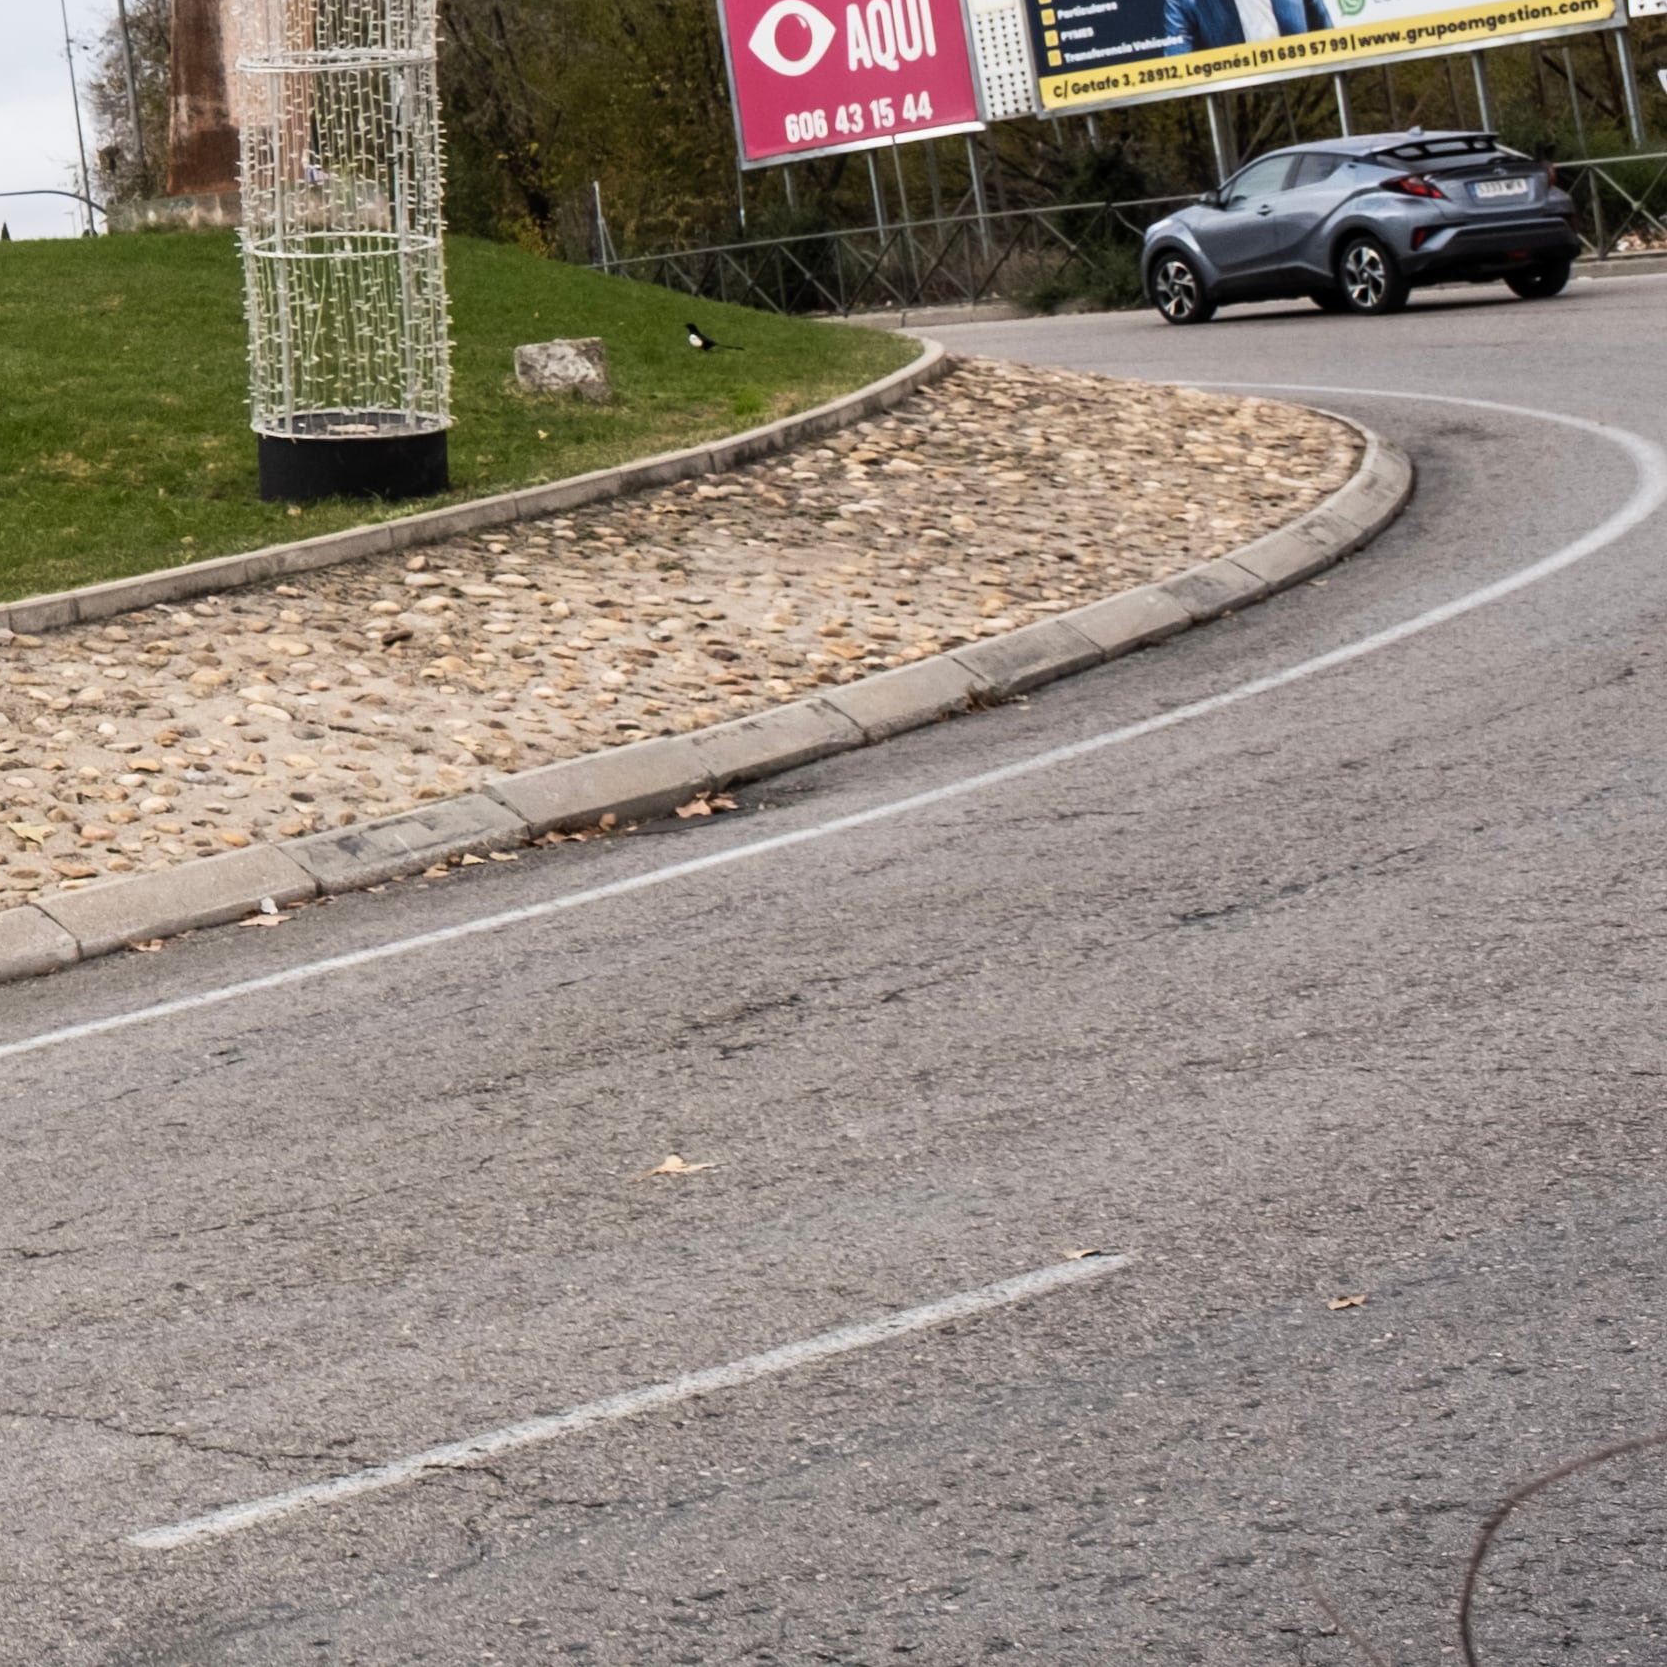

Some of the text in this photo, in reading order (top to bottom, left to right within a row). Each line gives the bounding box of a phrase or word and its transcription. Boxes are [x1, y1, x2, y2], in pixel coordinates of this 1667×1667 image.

[1056, 1, 1118, 21] Particulares
[1053, 80, 1069, 99] C/
[1071, 76, 1119, 95] Getafe
[1121, 73, 1136, 87] 3,
[1138, 65, 1184, 84] 28912,
[1186, 52, 1250, 77] Leganés
[1260, 47, 1274, 63] 91
[1278, 43, 1307, 62] 689
[1310, 40, 1327, 55] 57
[1330, 36, 1348, 52] 99
[784, 90, 934, 144] 606 43 15 44
